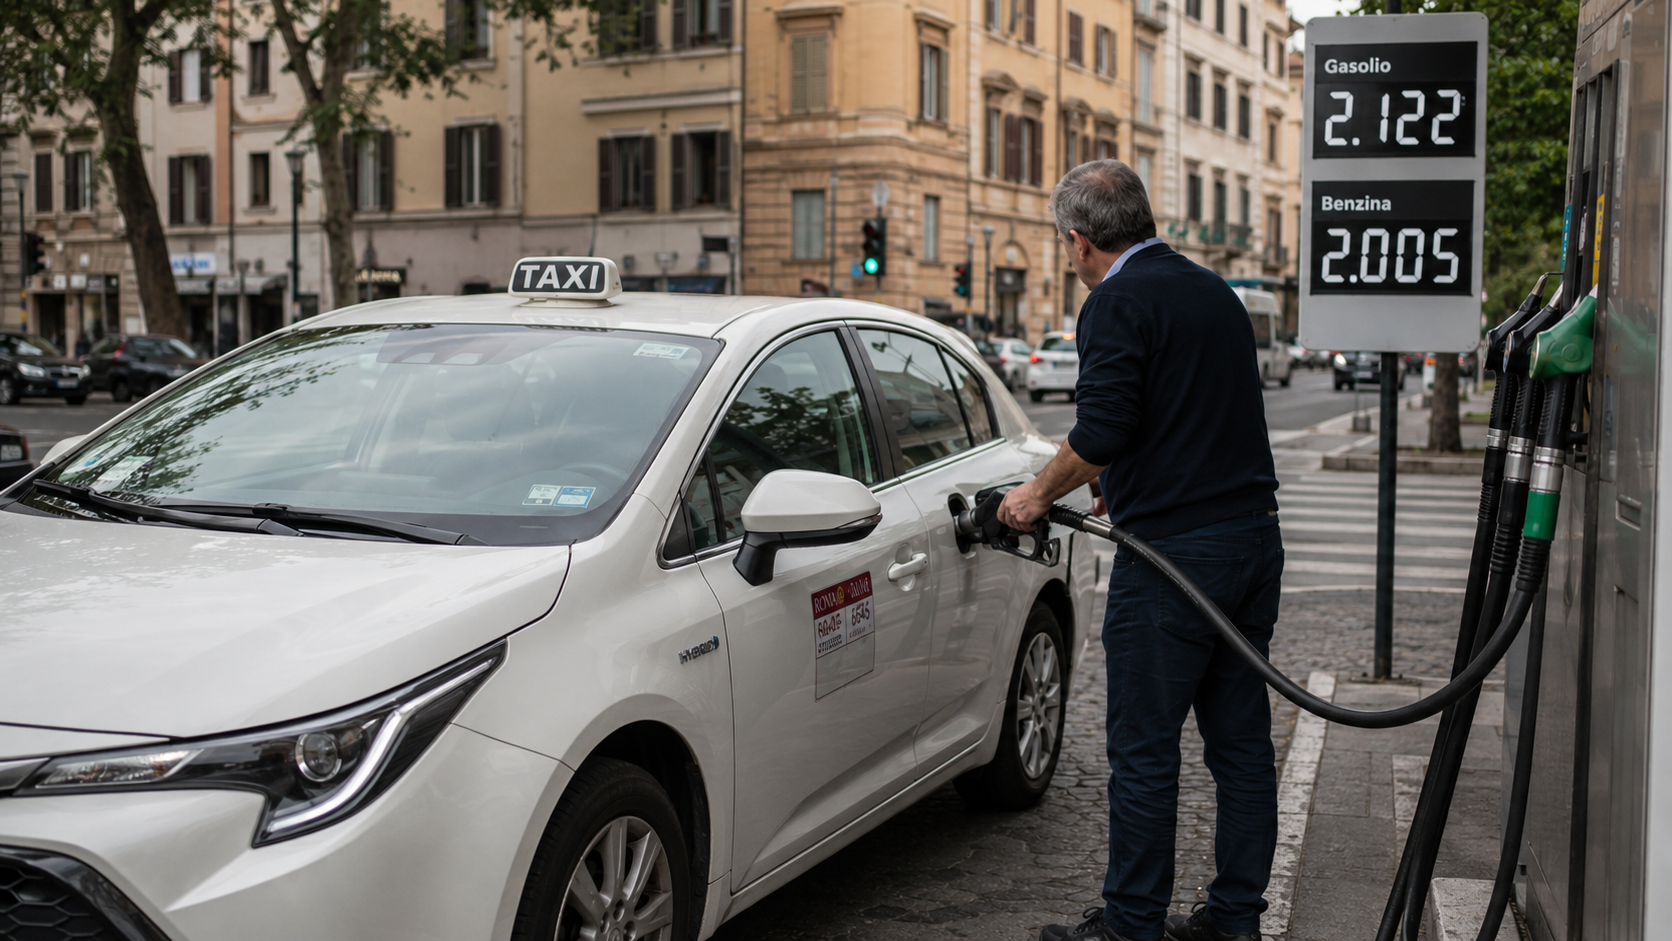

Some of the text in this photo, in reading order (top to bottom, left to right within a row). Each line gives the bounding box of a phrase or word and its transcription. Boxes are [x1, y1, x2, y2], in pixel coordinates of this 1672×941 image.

[1324, 57, 1391, 74] Gasolio
[1324, 89, 1461, 146] 2.122
[1321, 195, 1392, 211] Benzina
[1321, 228, 1459, 283] 2.005
[520, 265, 599, 289] TAXI
